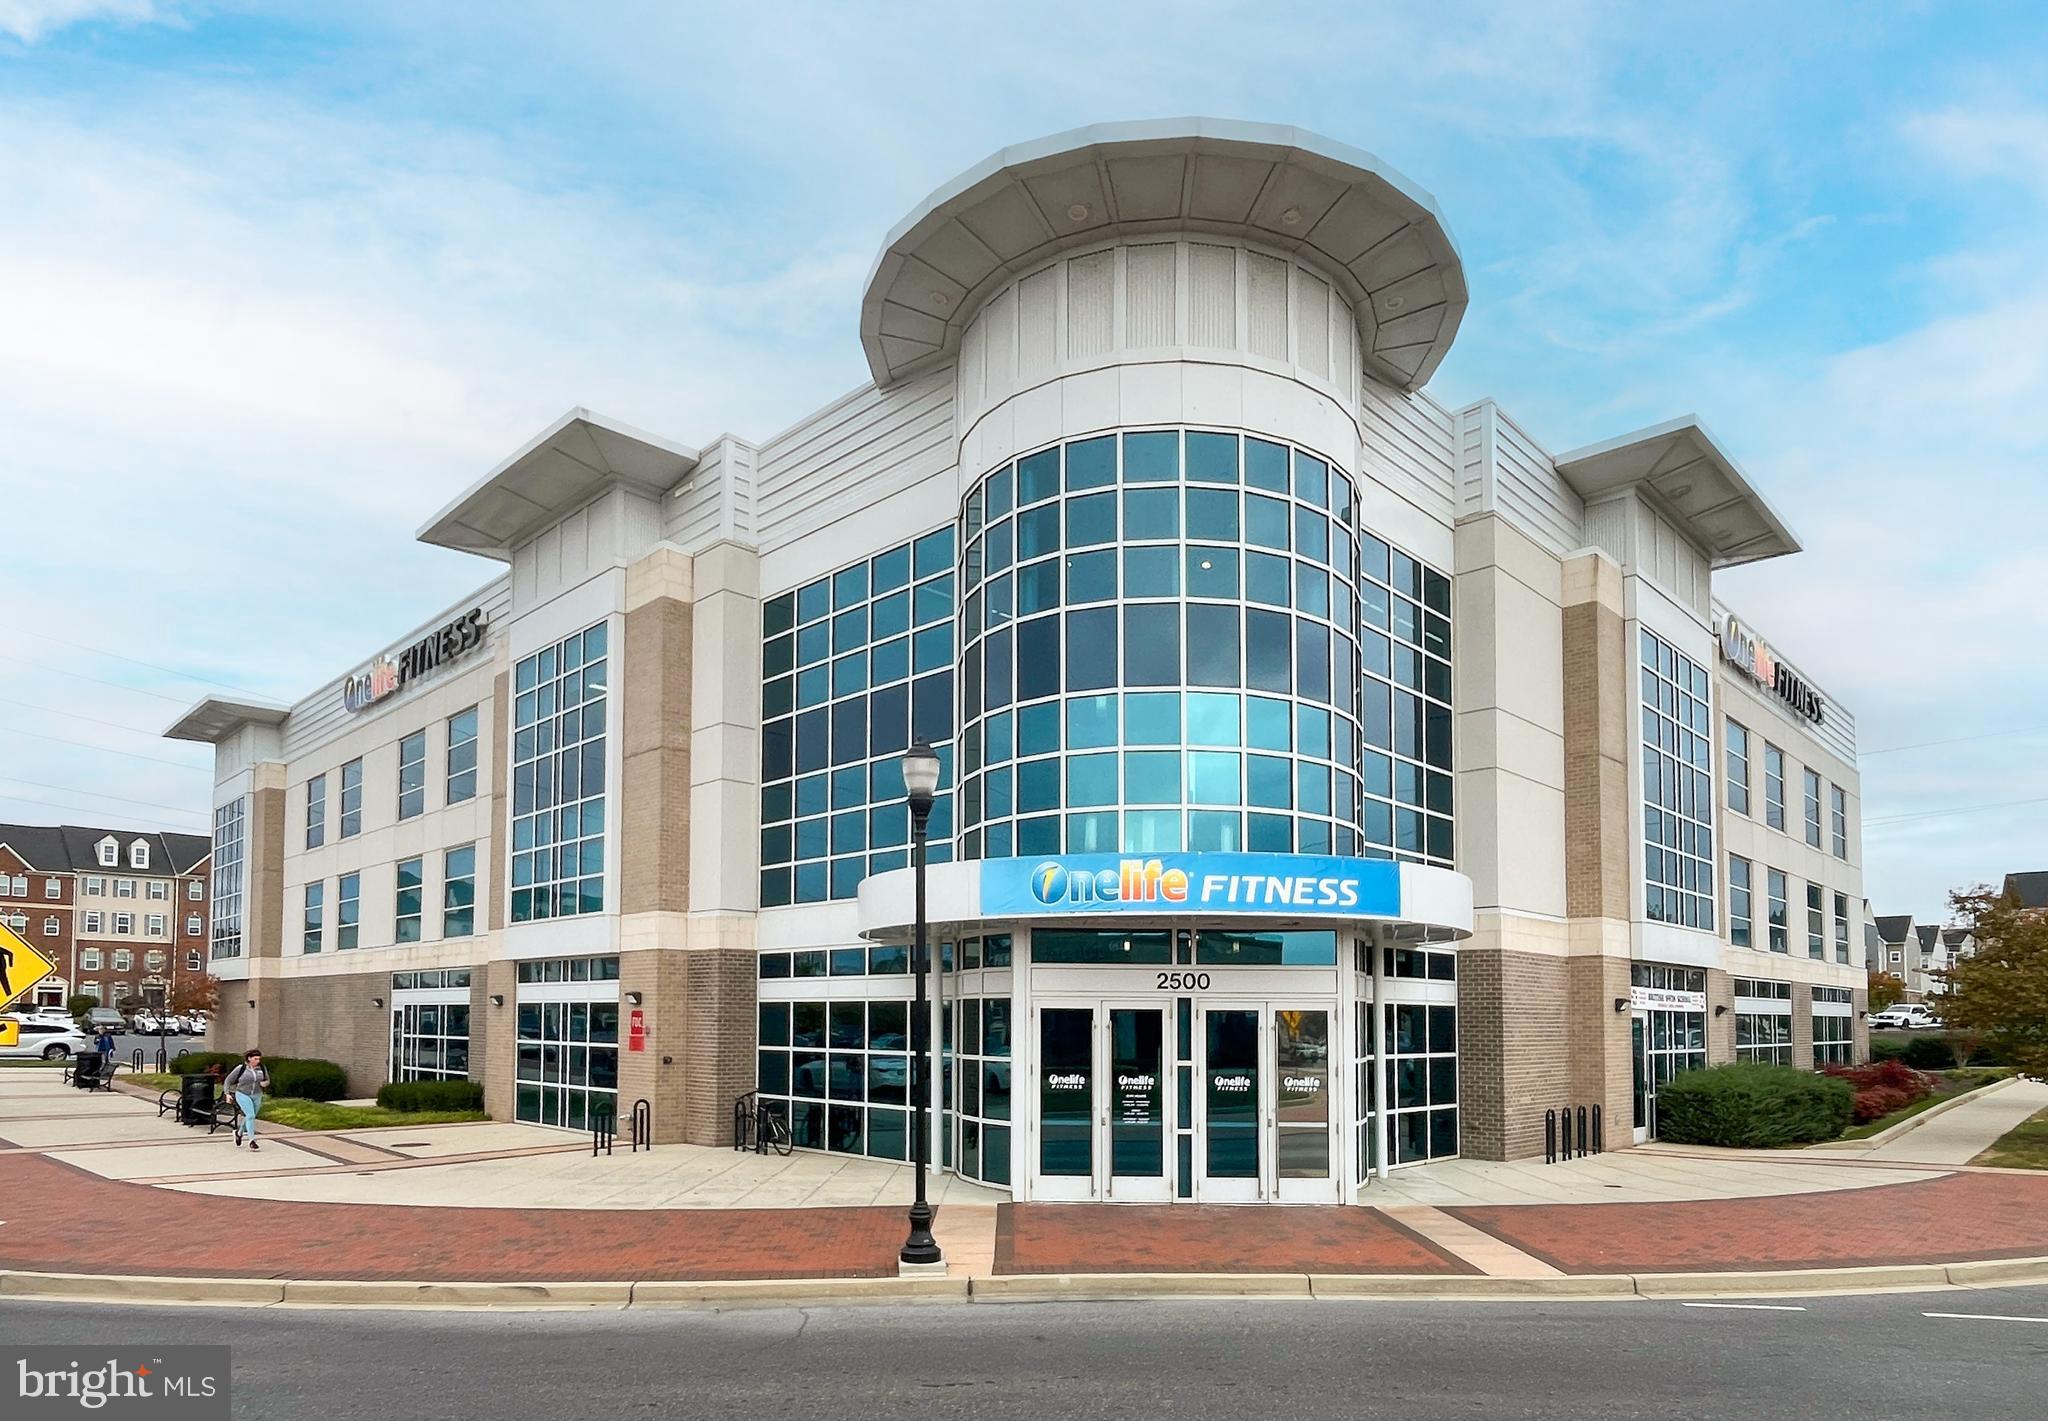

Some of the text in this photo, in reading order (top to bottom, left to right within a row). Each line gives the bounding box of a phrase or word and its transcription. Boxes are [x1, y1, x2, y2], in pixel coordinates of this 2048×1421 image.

[344, 607, 482, 713] Onelife FITNESS
[1774, 662, 1826, 725] FITNESS
[1031, 859, 1359, 906] Onelife FITNESS
[1156, 973, 1211, 990] 2500
[1048, 1074, 1085, 1084] Onelife
[1118, 1075, 1154, 1085] Onelife
[1215, 1076, 1250, 1086] Onelife
[1284, 1077, 1320, 1087] Onelife
